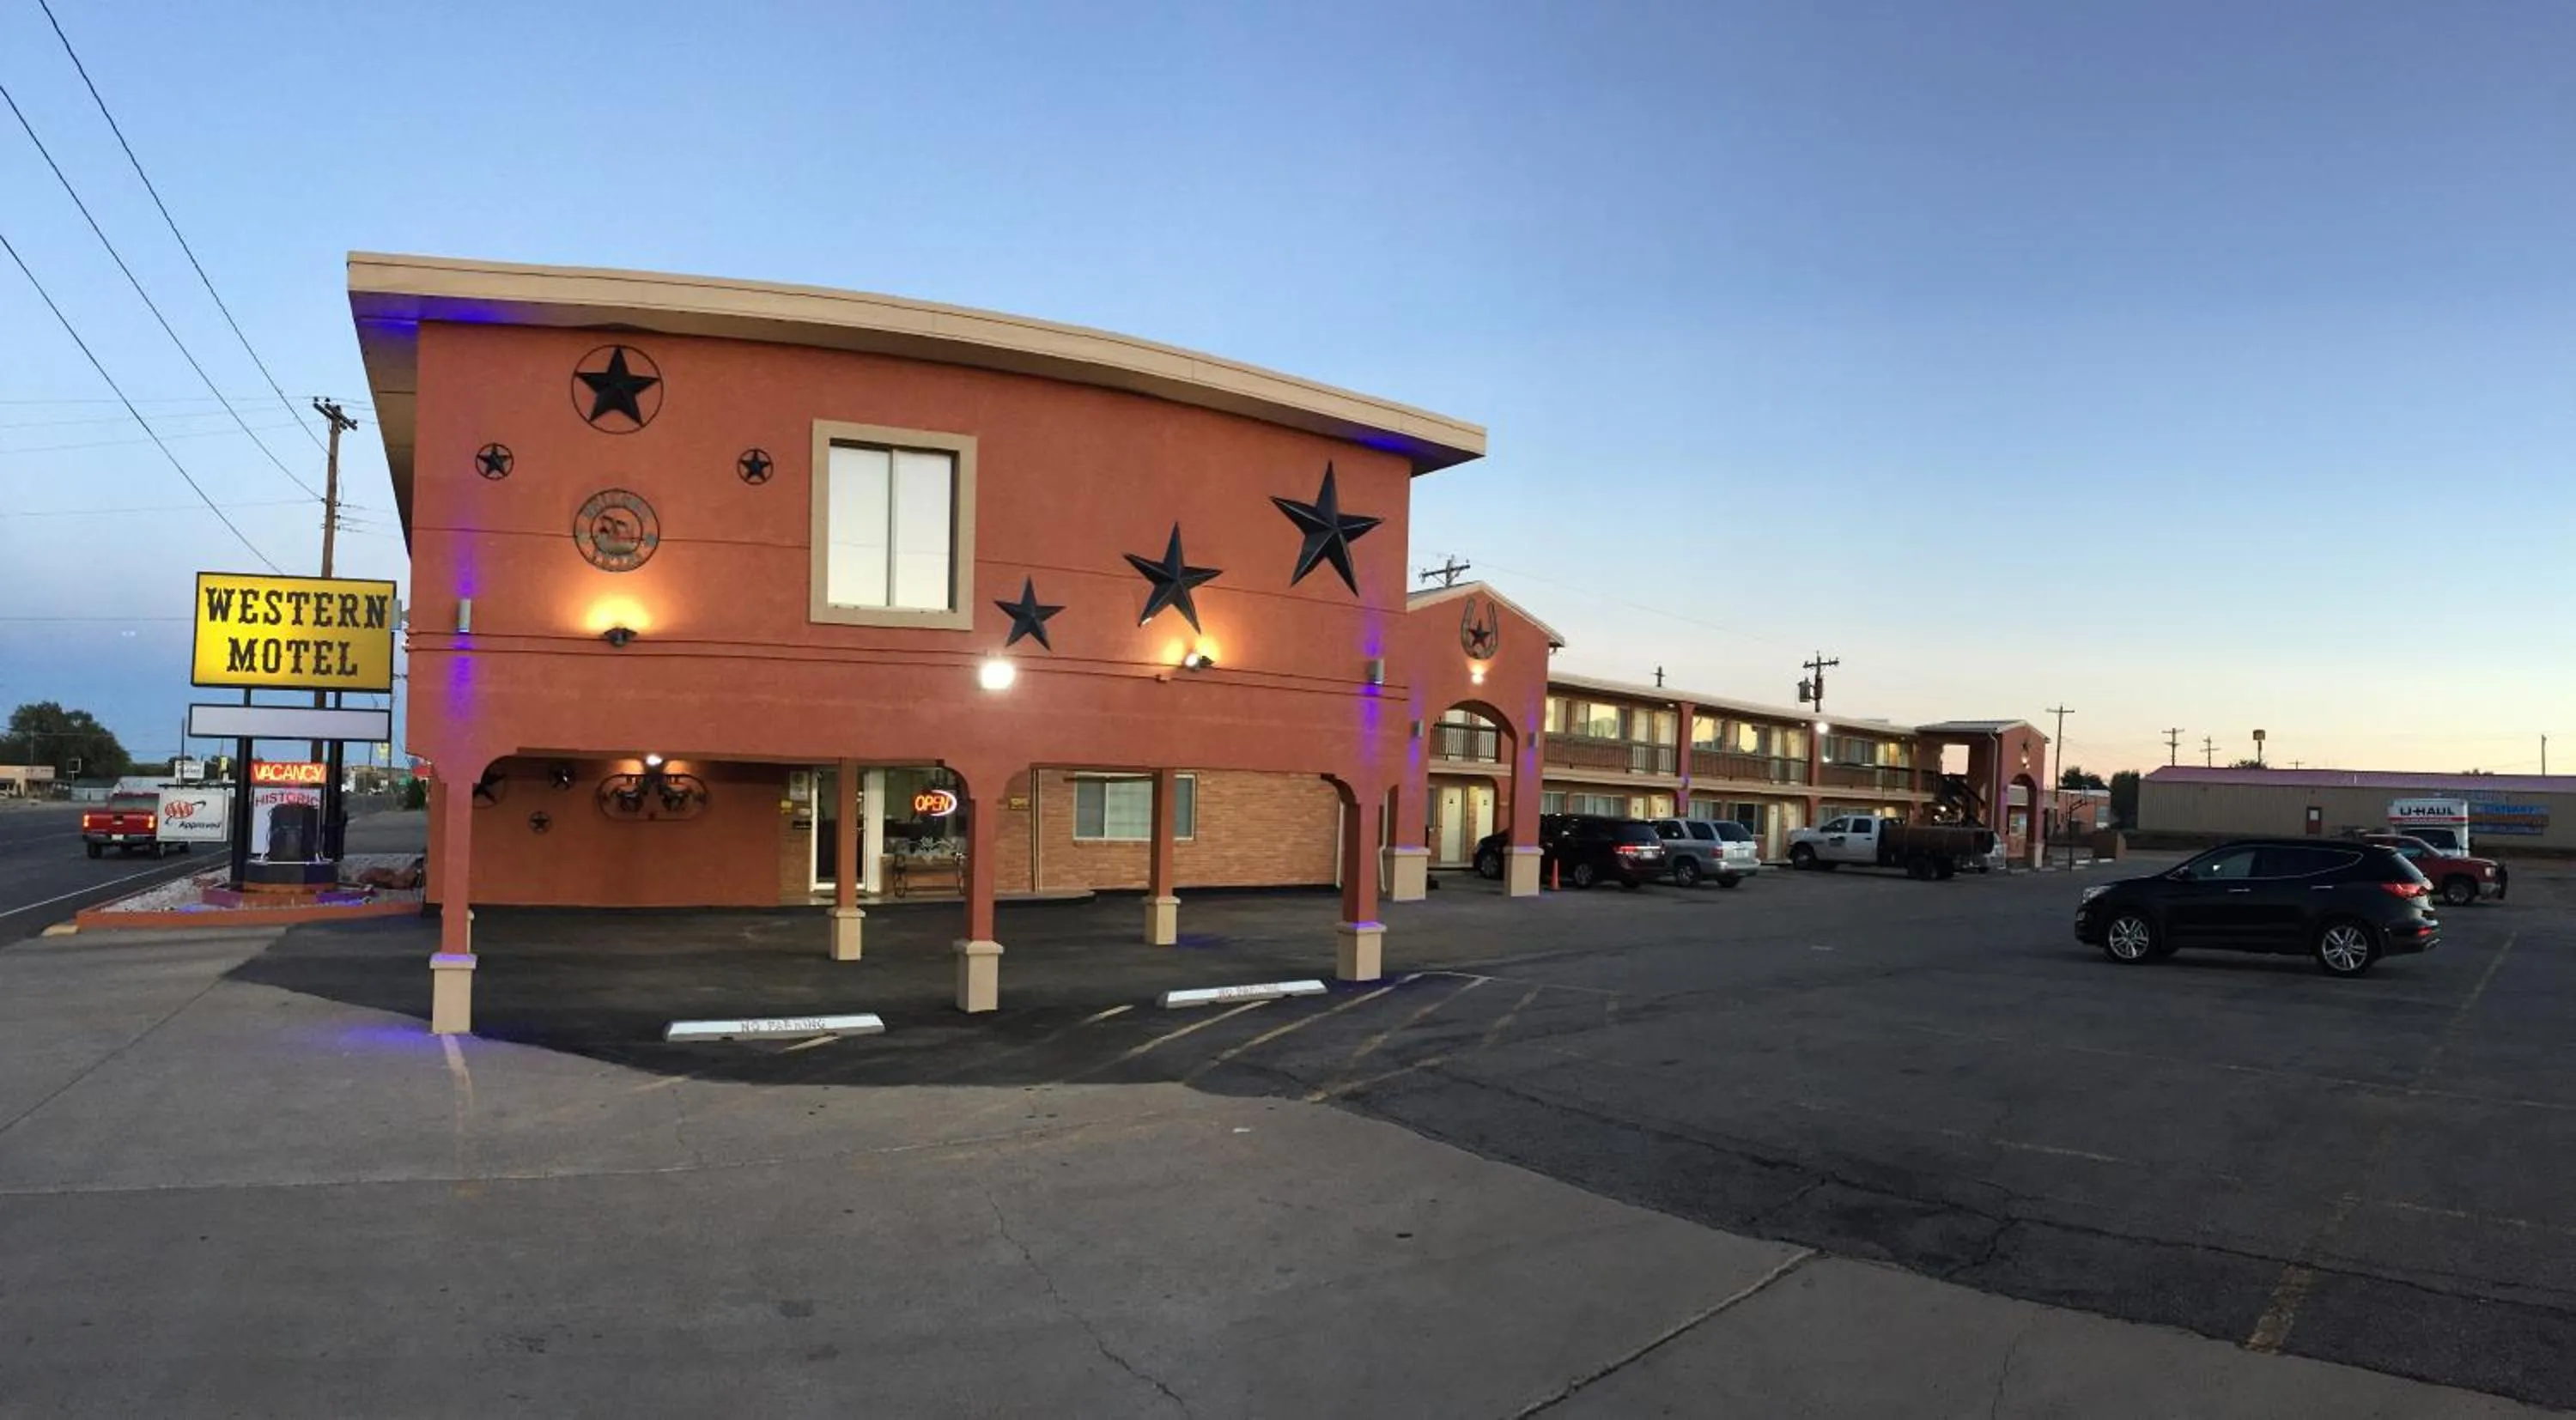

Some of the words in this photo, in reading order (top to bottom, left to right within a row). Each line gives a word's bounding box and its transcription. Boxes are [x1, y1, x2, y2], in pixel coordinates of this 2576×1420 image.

[206, 586, 389, 629] WESTERN
[227, 637, 358, 677] MOTEL
[254, 763, 325, 782] VACANCY
[256, 792, 320, 806] HISTORIC
[914, 795, 950, 810] OPEN
[2400, 806, 2457, 816] U-HAUL
[179, 820, 222, 833] Approved
[741, 1019, 759, 1033] NO
